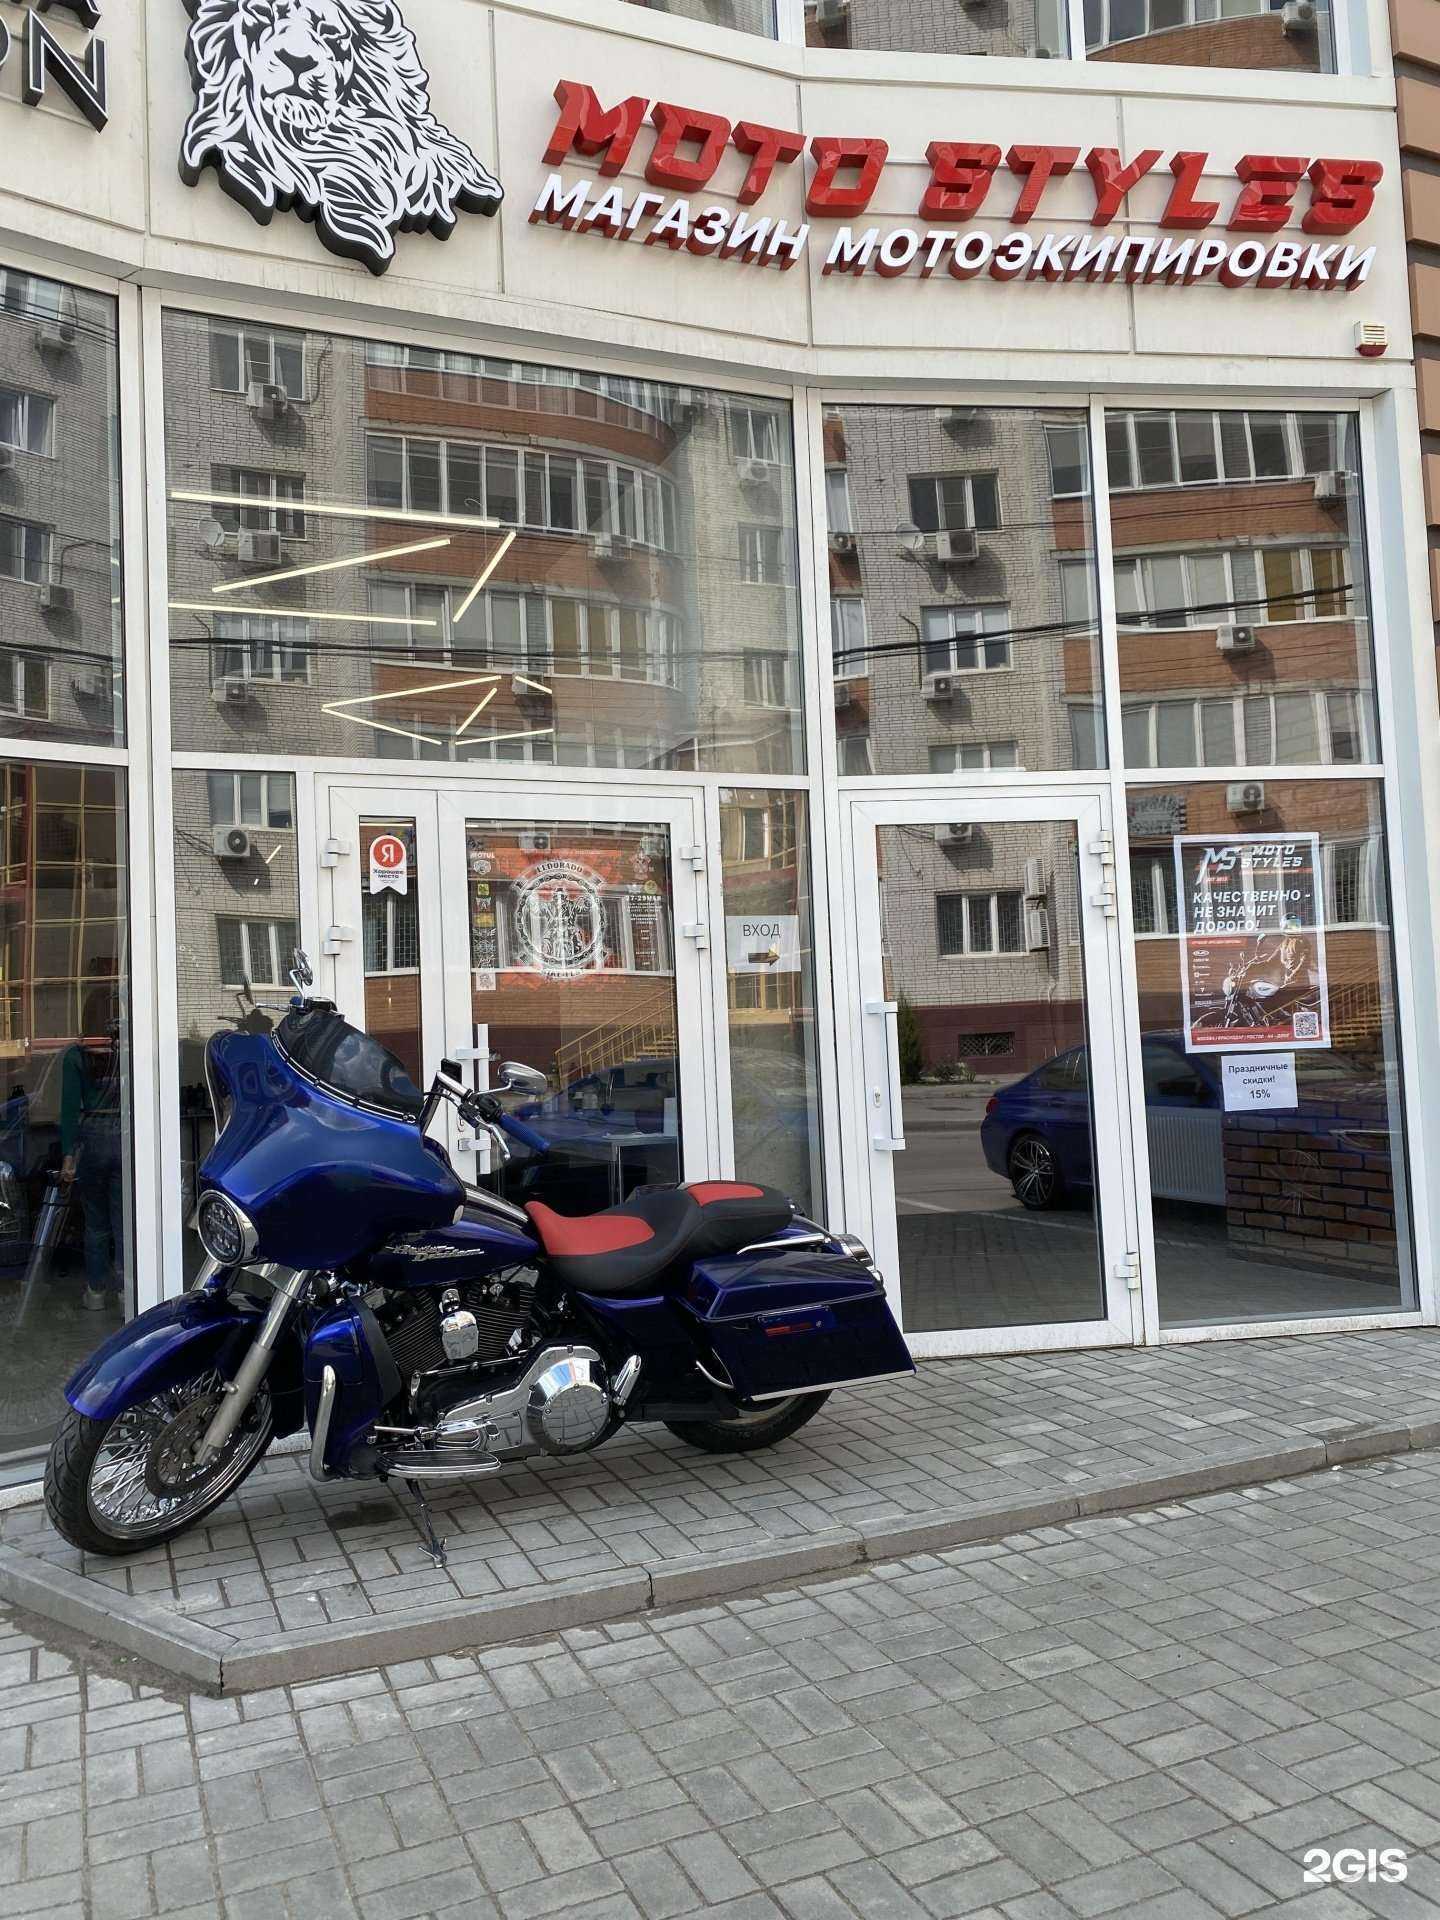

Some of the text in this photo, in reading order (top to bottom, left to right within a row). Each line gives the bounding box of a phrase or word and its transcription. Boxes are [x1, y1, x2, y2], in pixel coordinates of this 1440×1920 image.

[0, 8, 108, 133] N
[542, 79, 1384, 234] MOTO STYLES
[529, 174, 1377, 291] МАГАЗИН МОТОЭКИПИРОВКИ
[1251, 844, 1296, 856] MOTO
[1241, 856, 1303, 868] STYLES
[1193, 889, 1301, 904] КАЧЕСТВЕННО
[1194, 904, 1277, 918] НЕ ЗНАЧИТ
[743, 923, 781, 939] ВХОД
[1193, 919, 1261, 935] ДОРОГО!
[1228, 1062, 1289, 1074] Праздничные
[1242, 1075, 1276, 1085] скидки!
[1250, 1088, 1271, 1099] 15%
